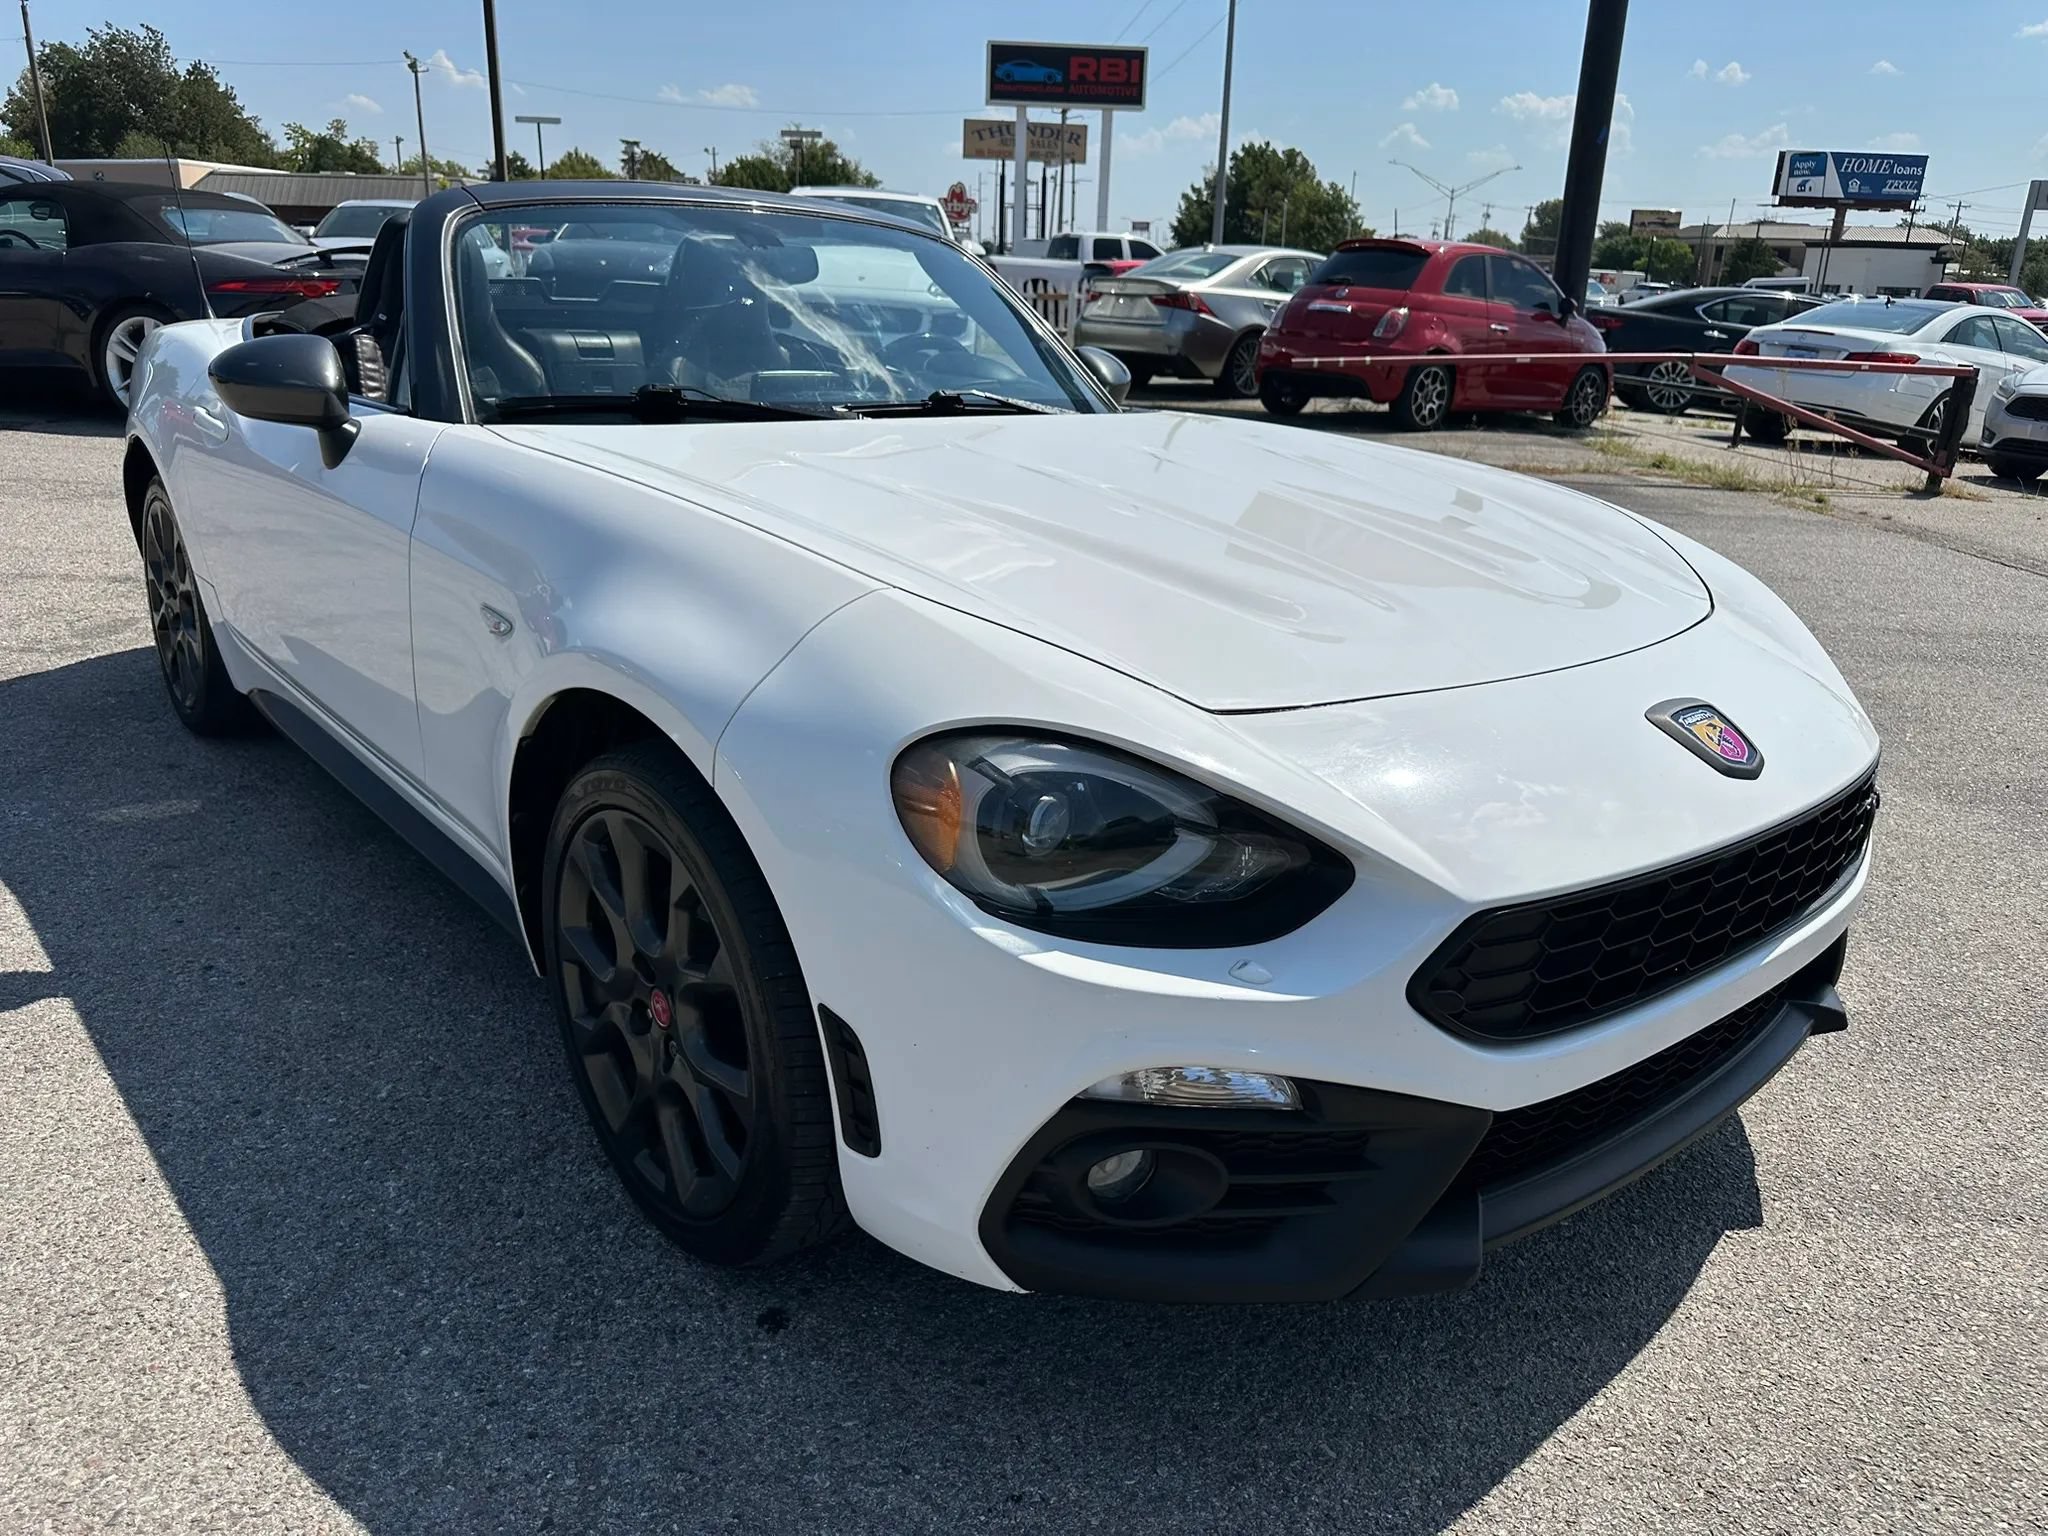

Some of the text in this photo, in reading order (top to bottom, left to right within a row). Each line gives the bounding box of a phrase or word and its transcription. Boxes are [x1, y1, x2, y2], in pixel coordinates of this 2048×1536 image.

[1070, 55, 1140, 83] RBI
[1069, 84, 1137, 97] AUTOMOTIVE
[1794, 160, 1816, 169] Apply
[1839, 157, 1923, 176] HOME loans
